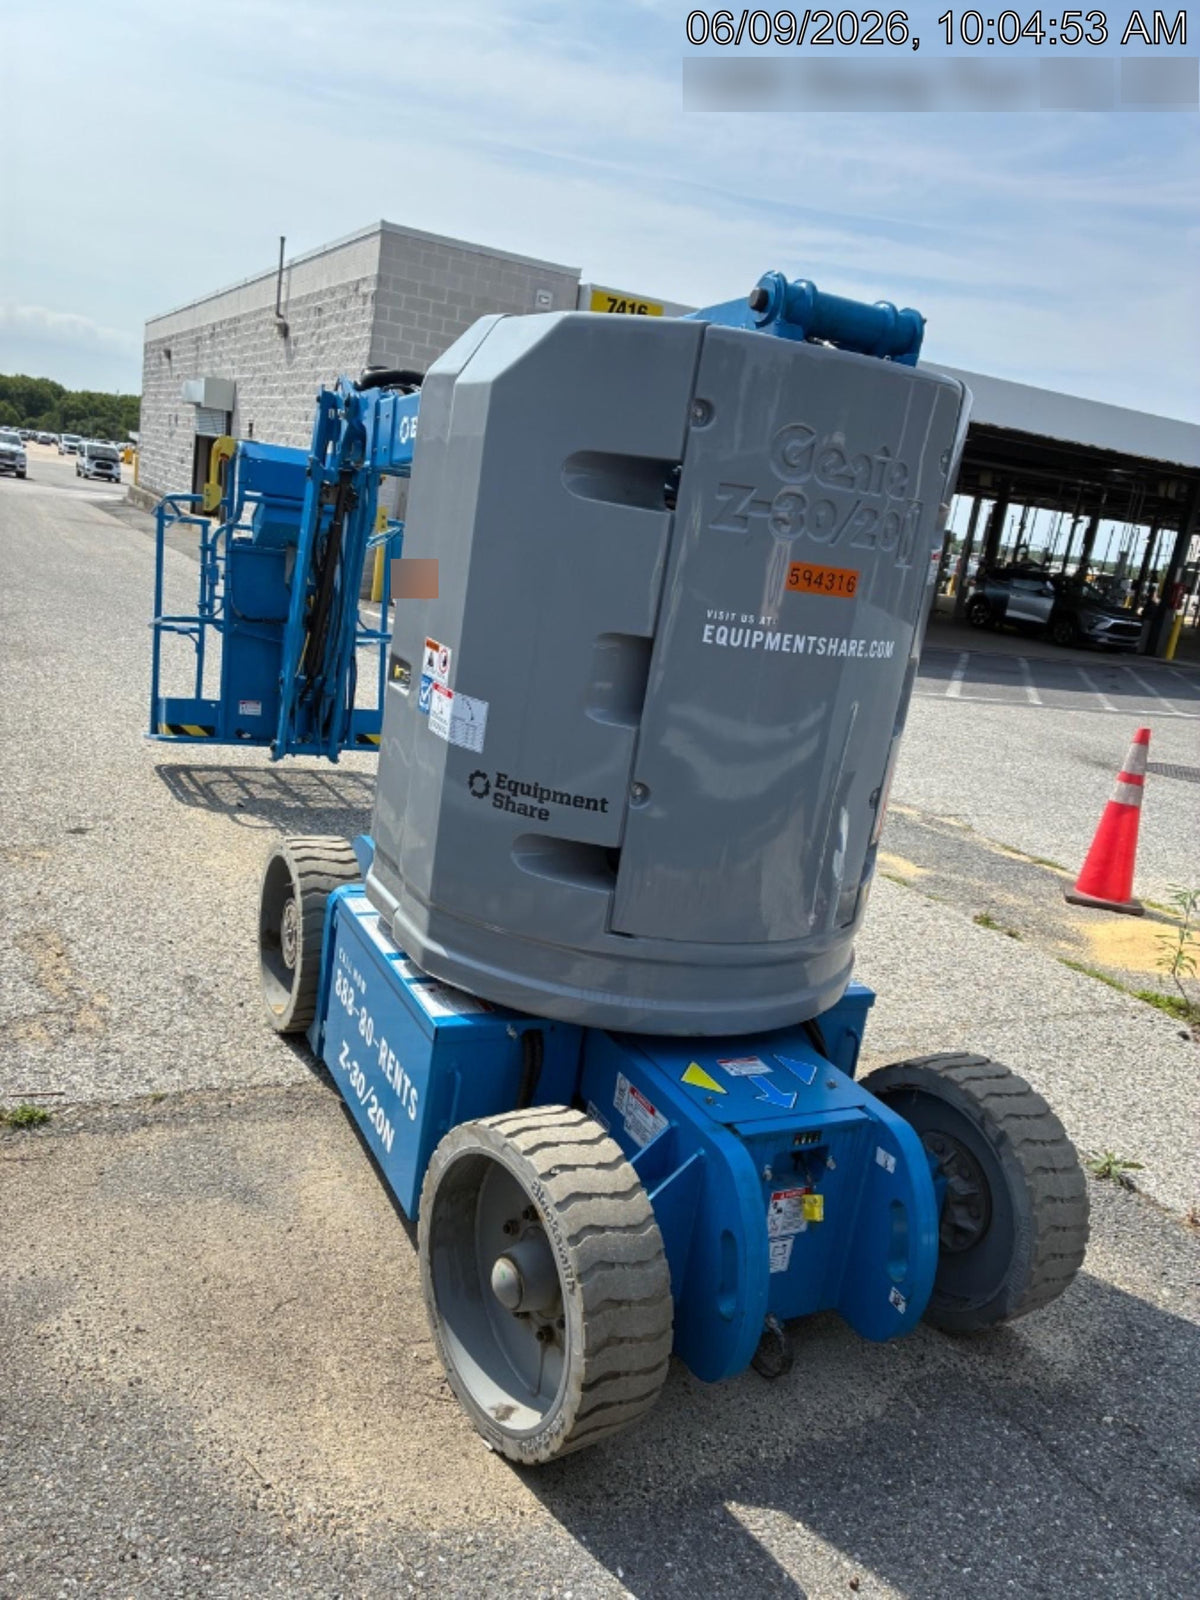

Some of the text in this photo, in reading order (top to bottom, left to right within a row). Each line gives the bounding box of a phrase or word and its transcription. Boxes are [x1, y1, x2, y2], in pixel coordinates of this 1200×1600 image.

[769, 422, 909, 501] Genie
[788, 567, 857, 594] 594316
[706, 609, 736, 621] VISIT
[740, 614, 755, 625] US
[702, 624, 896, 660] EQUIPMENTSHARE.COM
[492, 793, 551, 822] Share
[494, 771, 609, 814] Equipment
[335, 968, 419, 1121] 888-80-RENTS
